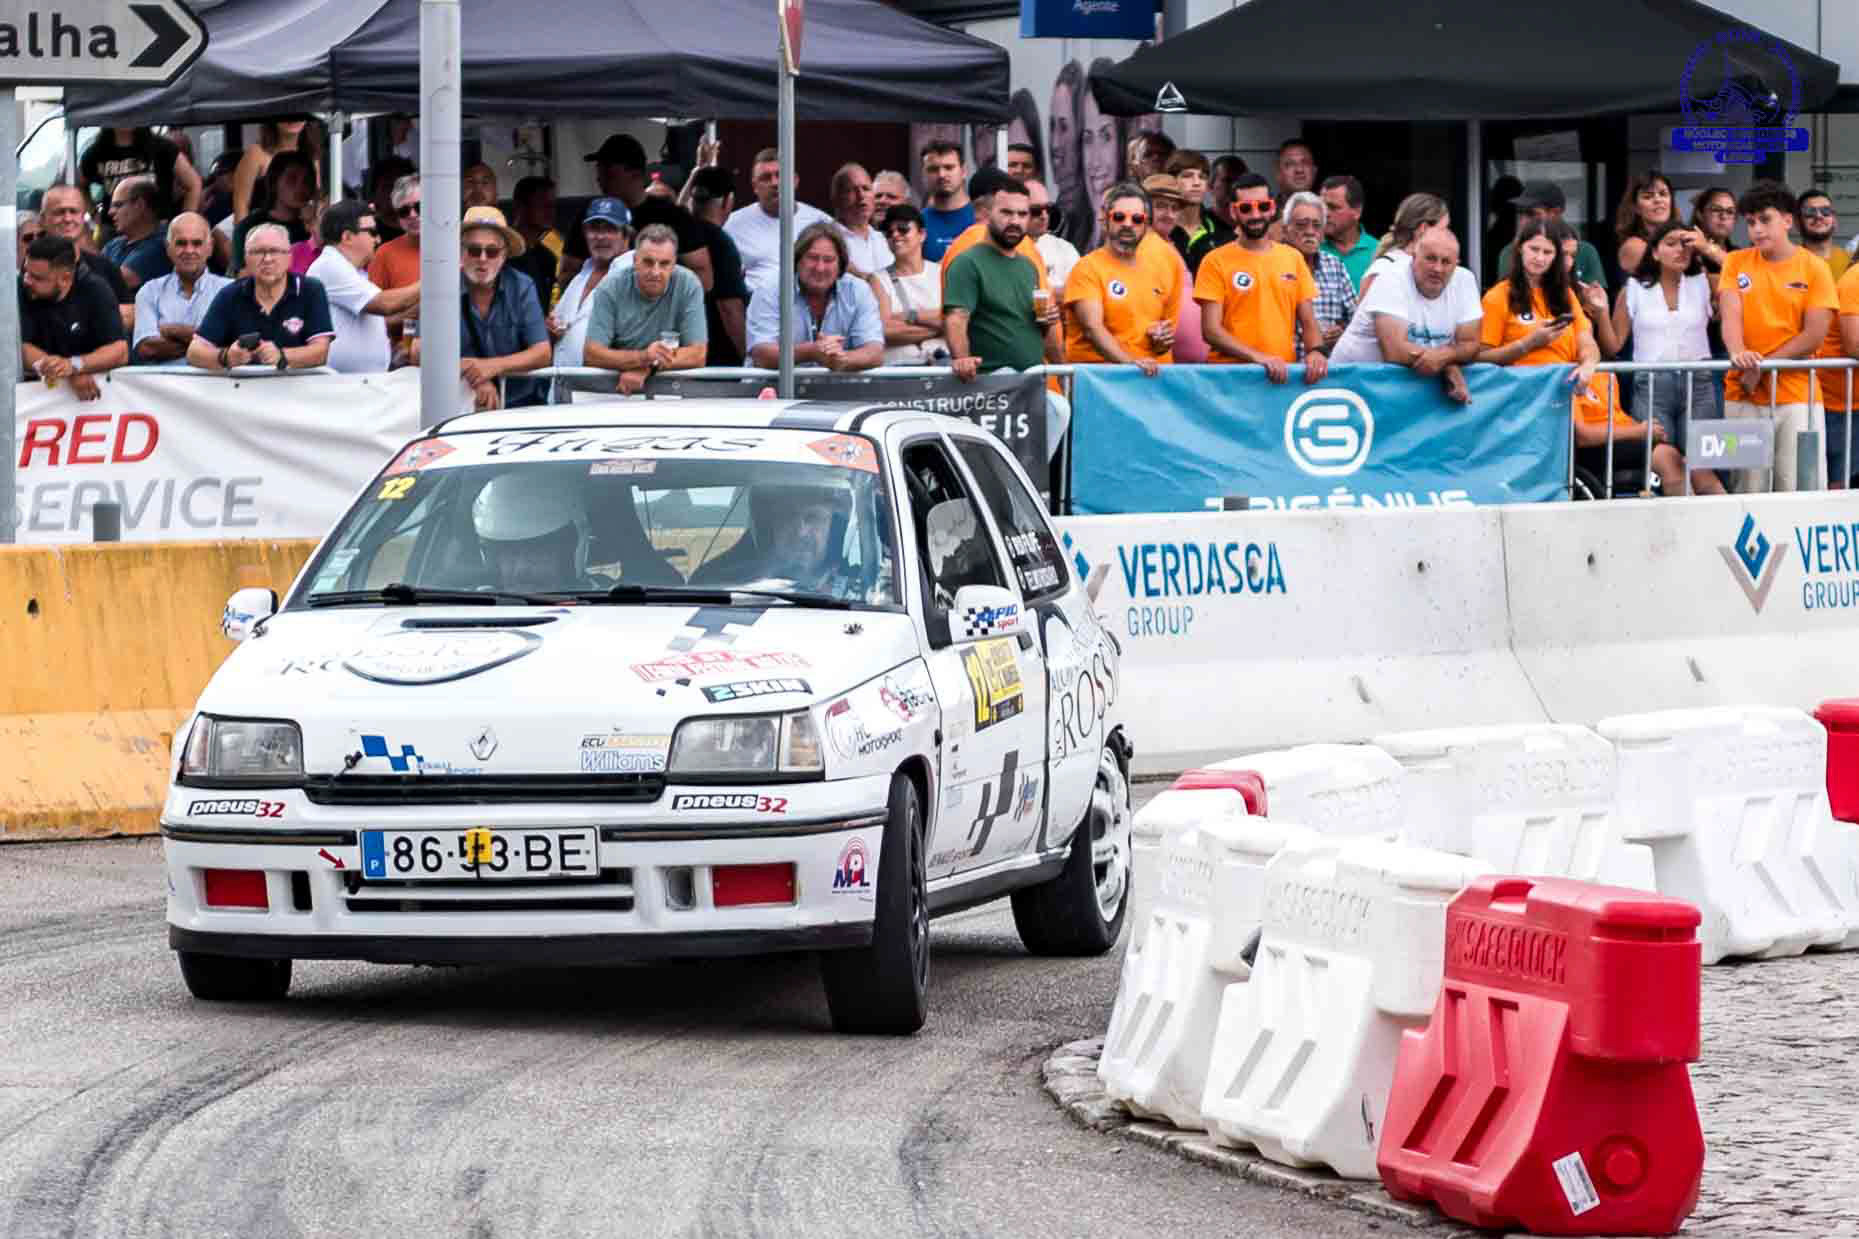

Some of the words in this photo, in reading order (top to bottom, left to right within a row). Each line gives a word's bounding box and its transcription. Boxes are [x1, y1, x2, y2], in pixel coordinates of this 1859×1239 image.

[965, 413, 1031, 439] EIS
[18, 413, 160, 468] RED
[378, 476, 416, 499] 12
[1117, 542, 1287, 598] VERDASCA
[1127, 605, 1194, 636] GROUP
[581, 751, 665, 772] Williams
[370, 859, 380, 871] P
